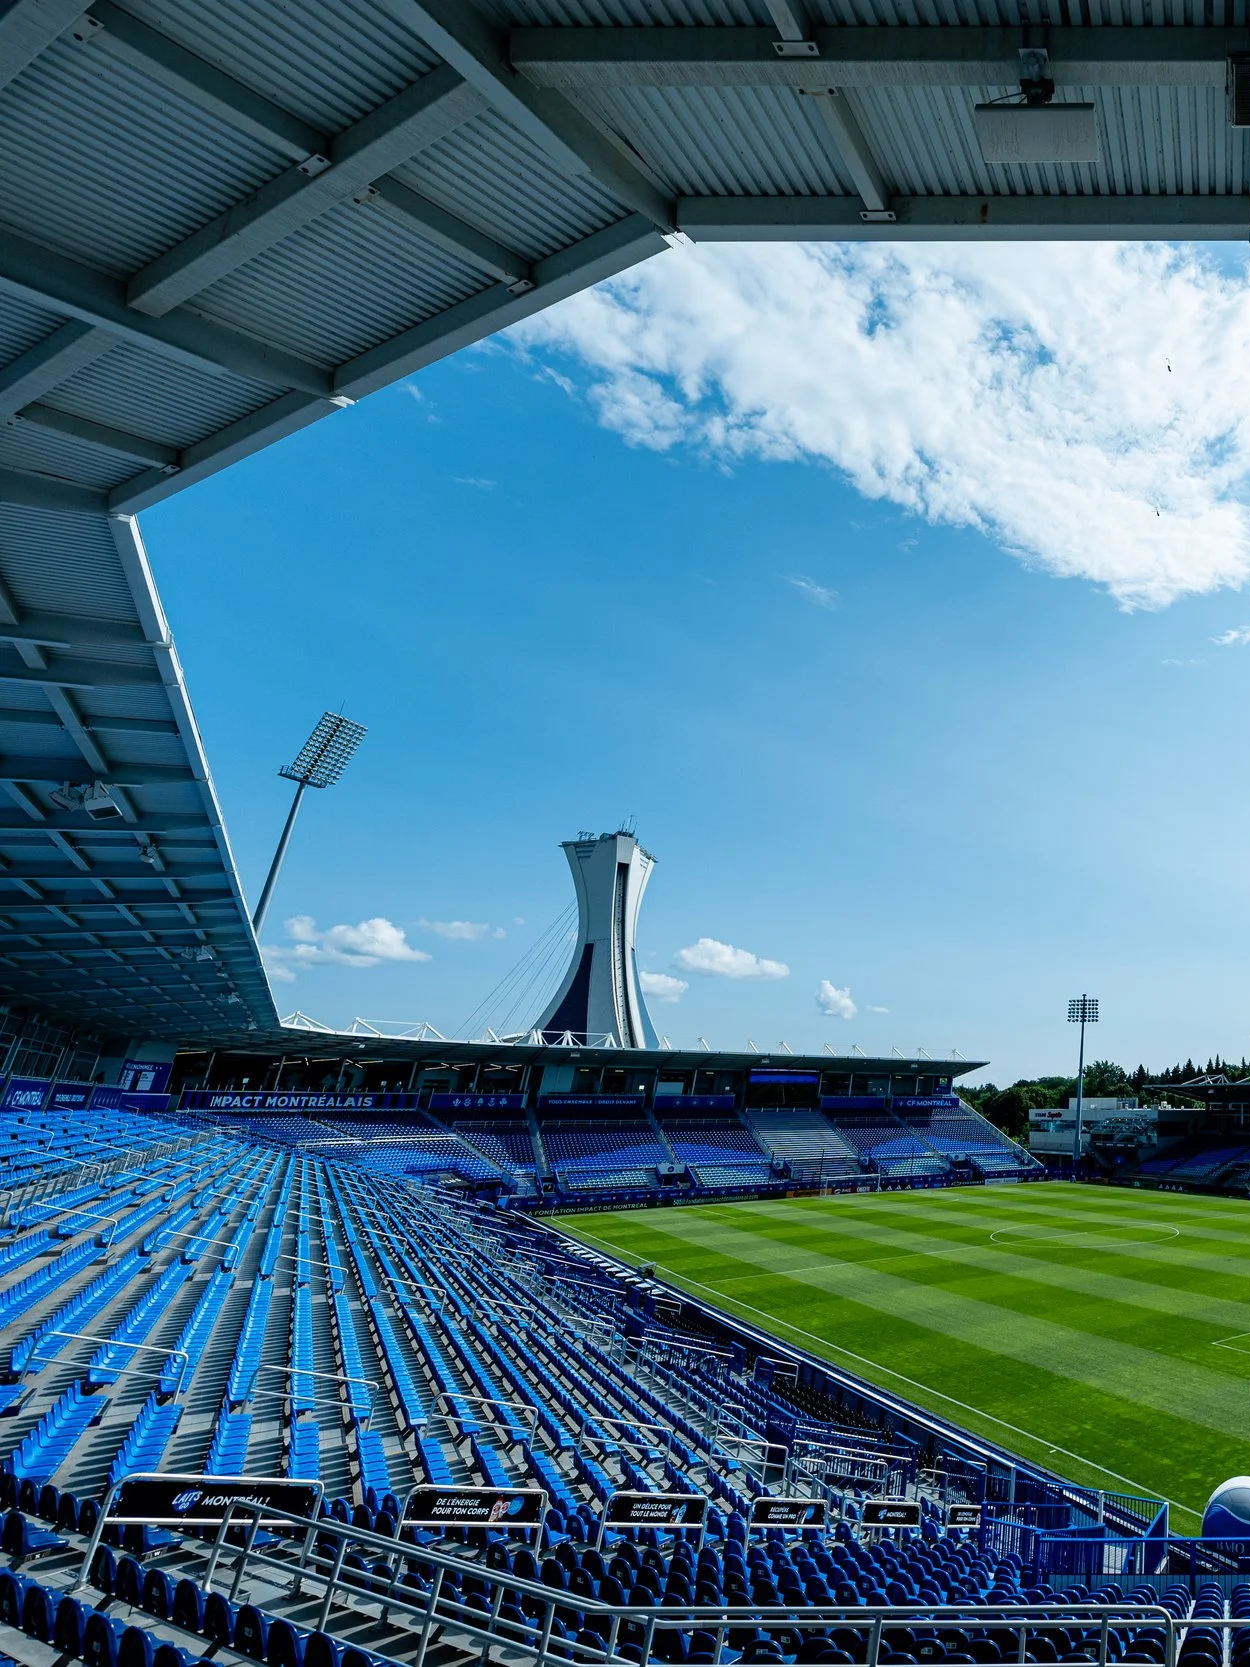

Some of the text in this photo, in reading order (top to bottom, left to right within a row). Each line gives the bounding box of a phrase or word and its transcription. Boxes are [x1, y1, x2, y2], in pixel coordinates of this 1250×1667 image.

[210, 1095, 373, 1107] IMPACT MONTRÉALAIS
[916, 1099, 952, 1107] MONTRÉAL
[612, 1202, 648, 1210] MONTRÉAL
[436, 1497, 480, 1506] DE L'ÉNERGIE
[641, 1502, 657, 1510] DÉLICE
[431, 1507, 490, 1515] POUR TON CORPS
[1216, 1541, 1245, 1554] BMO
